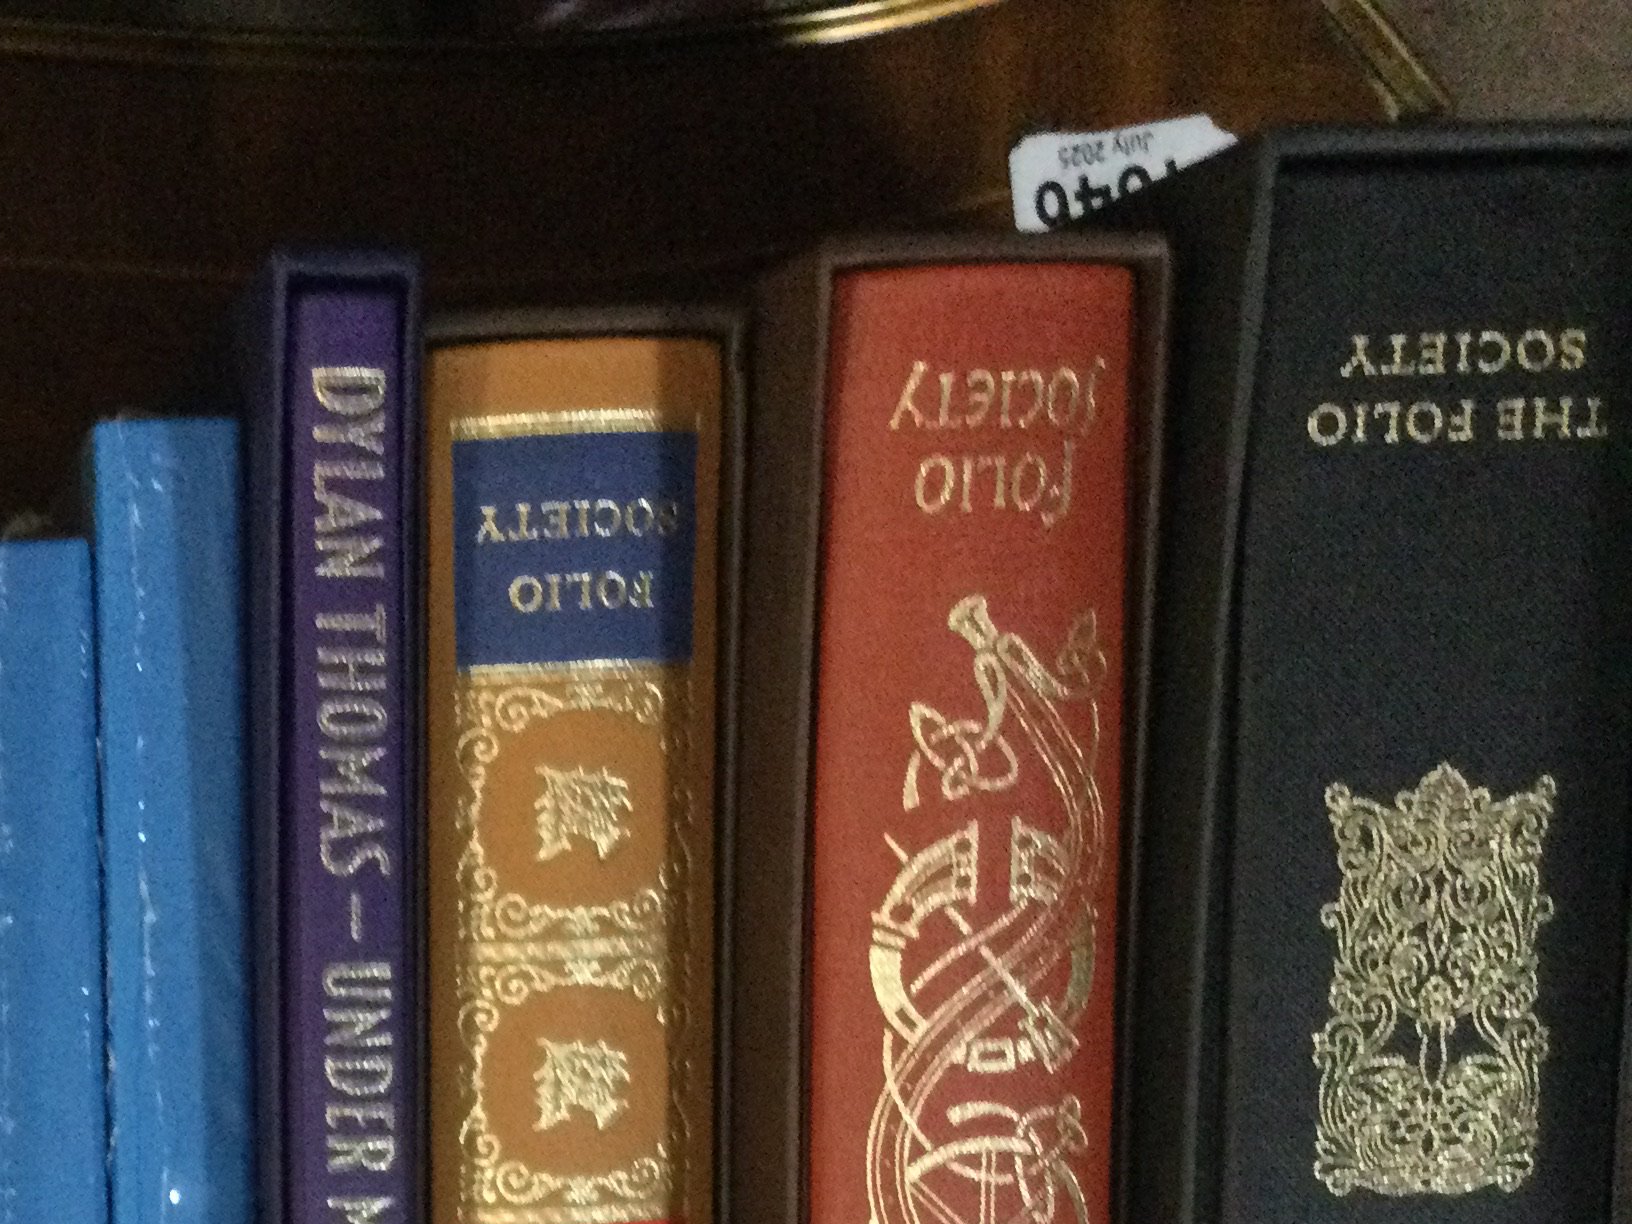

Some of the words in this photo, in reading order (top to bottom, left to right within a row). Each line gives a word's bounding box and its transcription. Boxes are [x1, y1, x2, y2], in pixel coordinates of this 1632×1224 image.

[1340, 328, 1587, 378] SOCIETY
[1307, 398, 1474, 446] FOLIO
[1497, 397, 1608, 441] THE
[311, 366, 386, 579] DYLAN
[476, 498, 679, 544] SOCIETY
[508, 570, 654, 614] FOLIO
[314, 603, 390, 877] THOMAS
[322, 961, 396, 1174] UNDER
